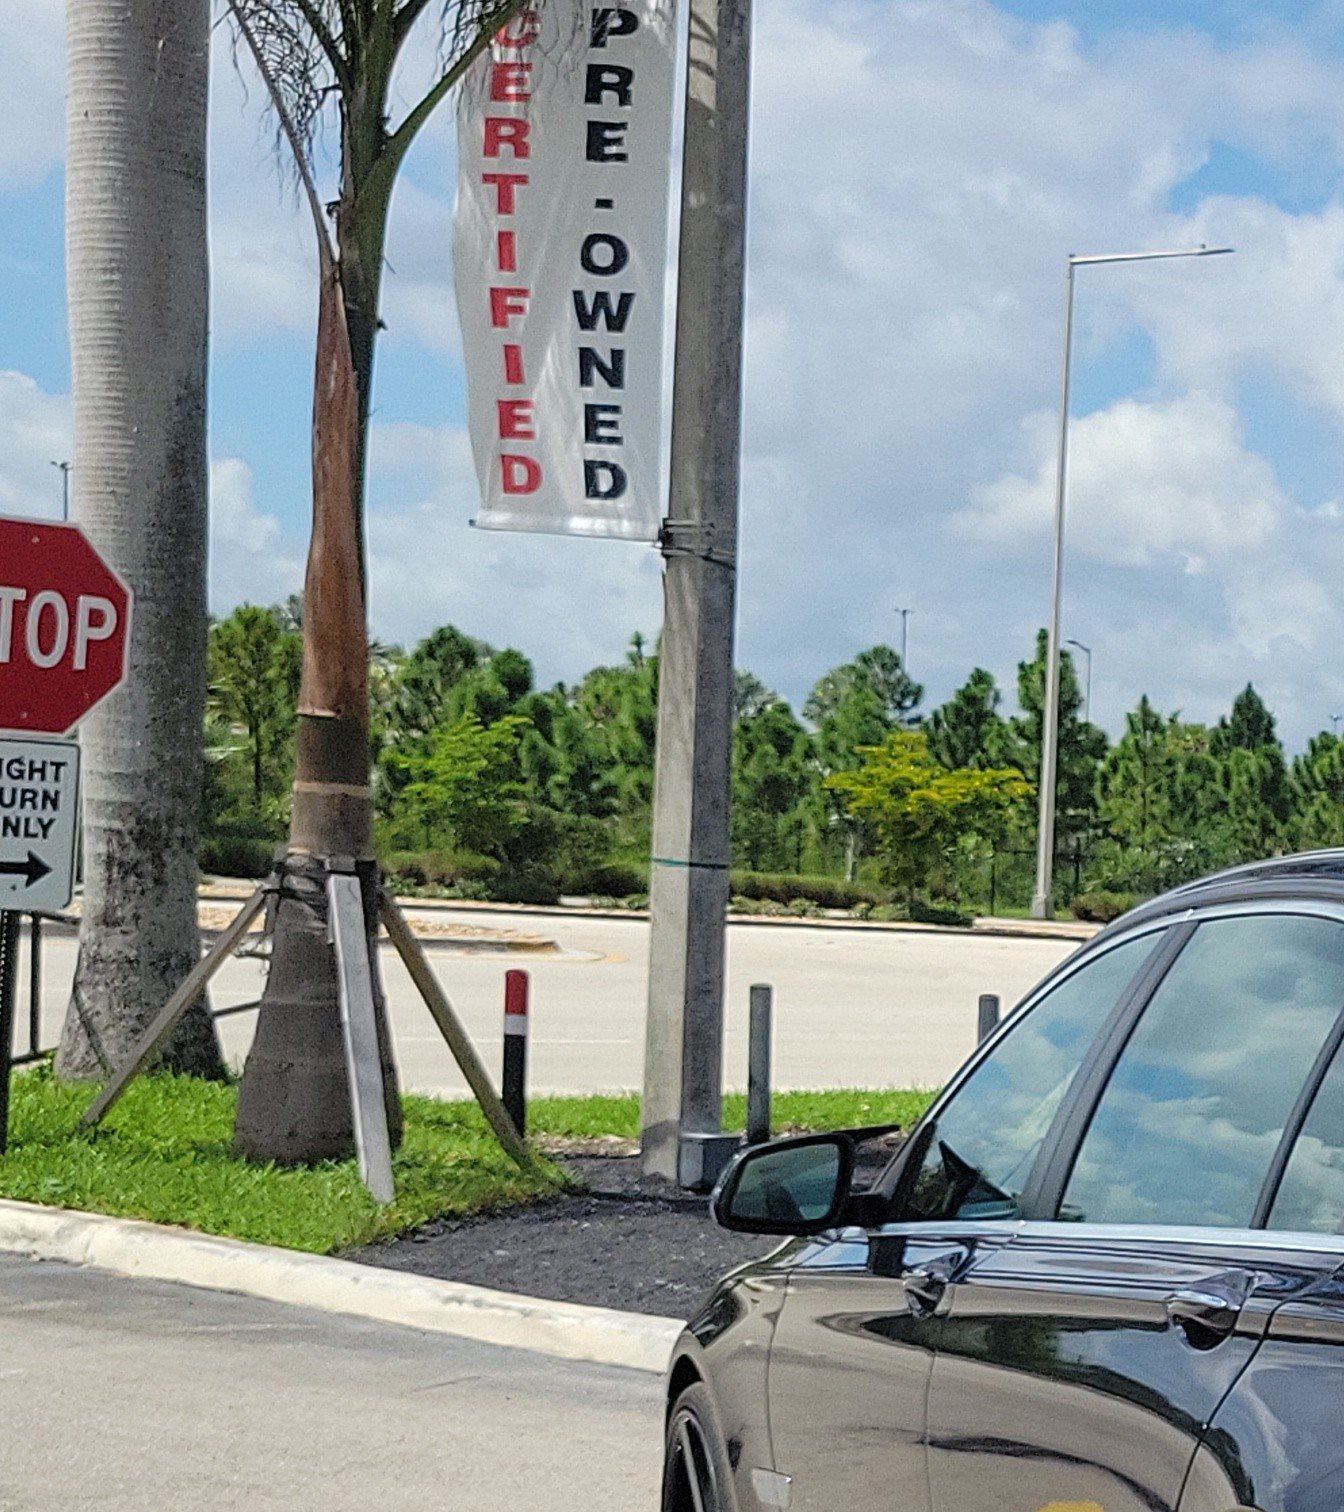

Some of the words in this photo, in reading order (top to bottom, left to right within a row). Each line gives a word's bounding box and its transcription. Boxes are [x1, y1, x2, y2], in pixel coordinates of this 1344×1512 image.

[480, 8, 543, 495] CERTIFIED
[572, 8, 640, 501] PRE-OWNED
[0, 586, 117, 670] TOP
[0, 757, 68, 783] IGHT
[0, 787, 61, 812] URN
[2, 816, 56, 840] NLY
